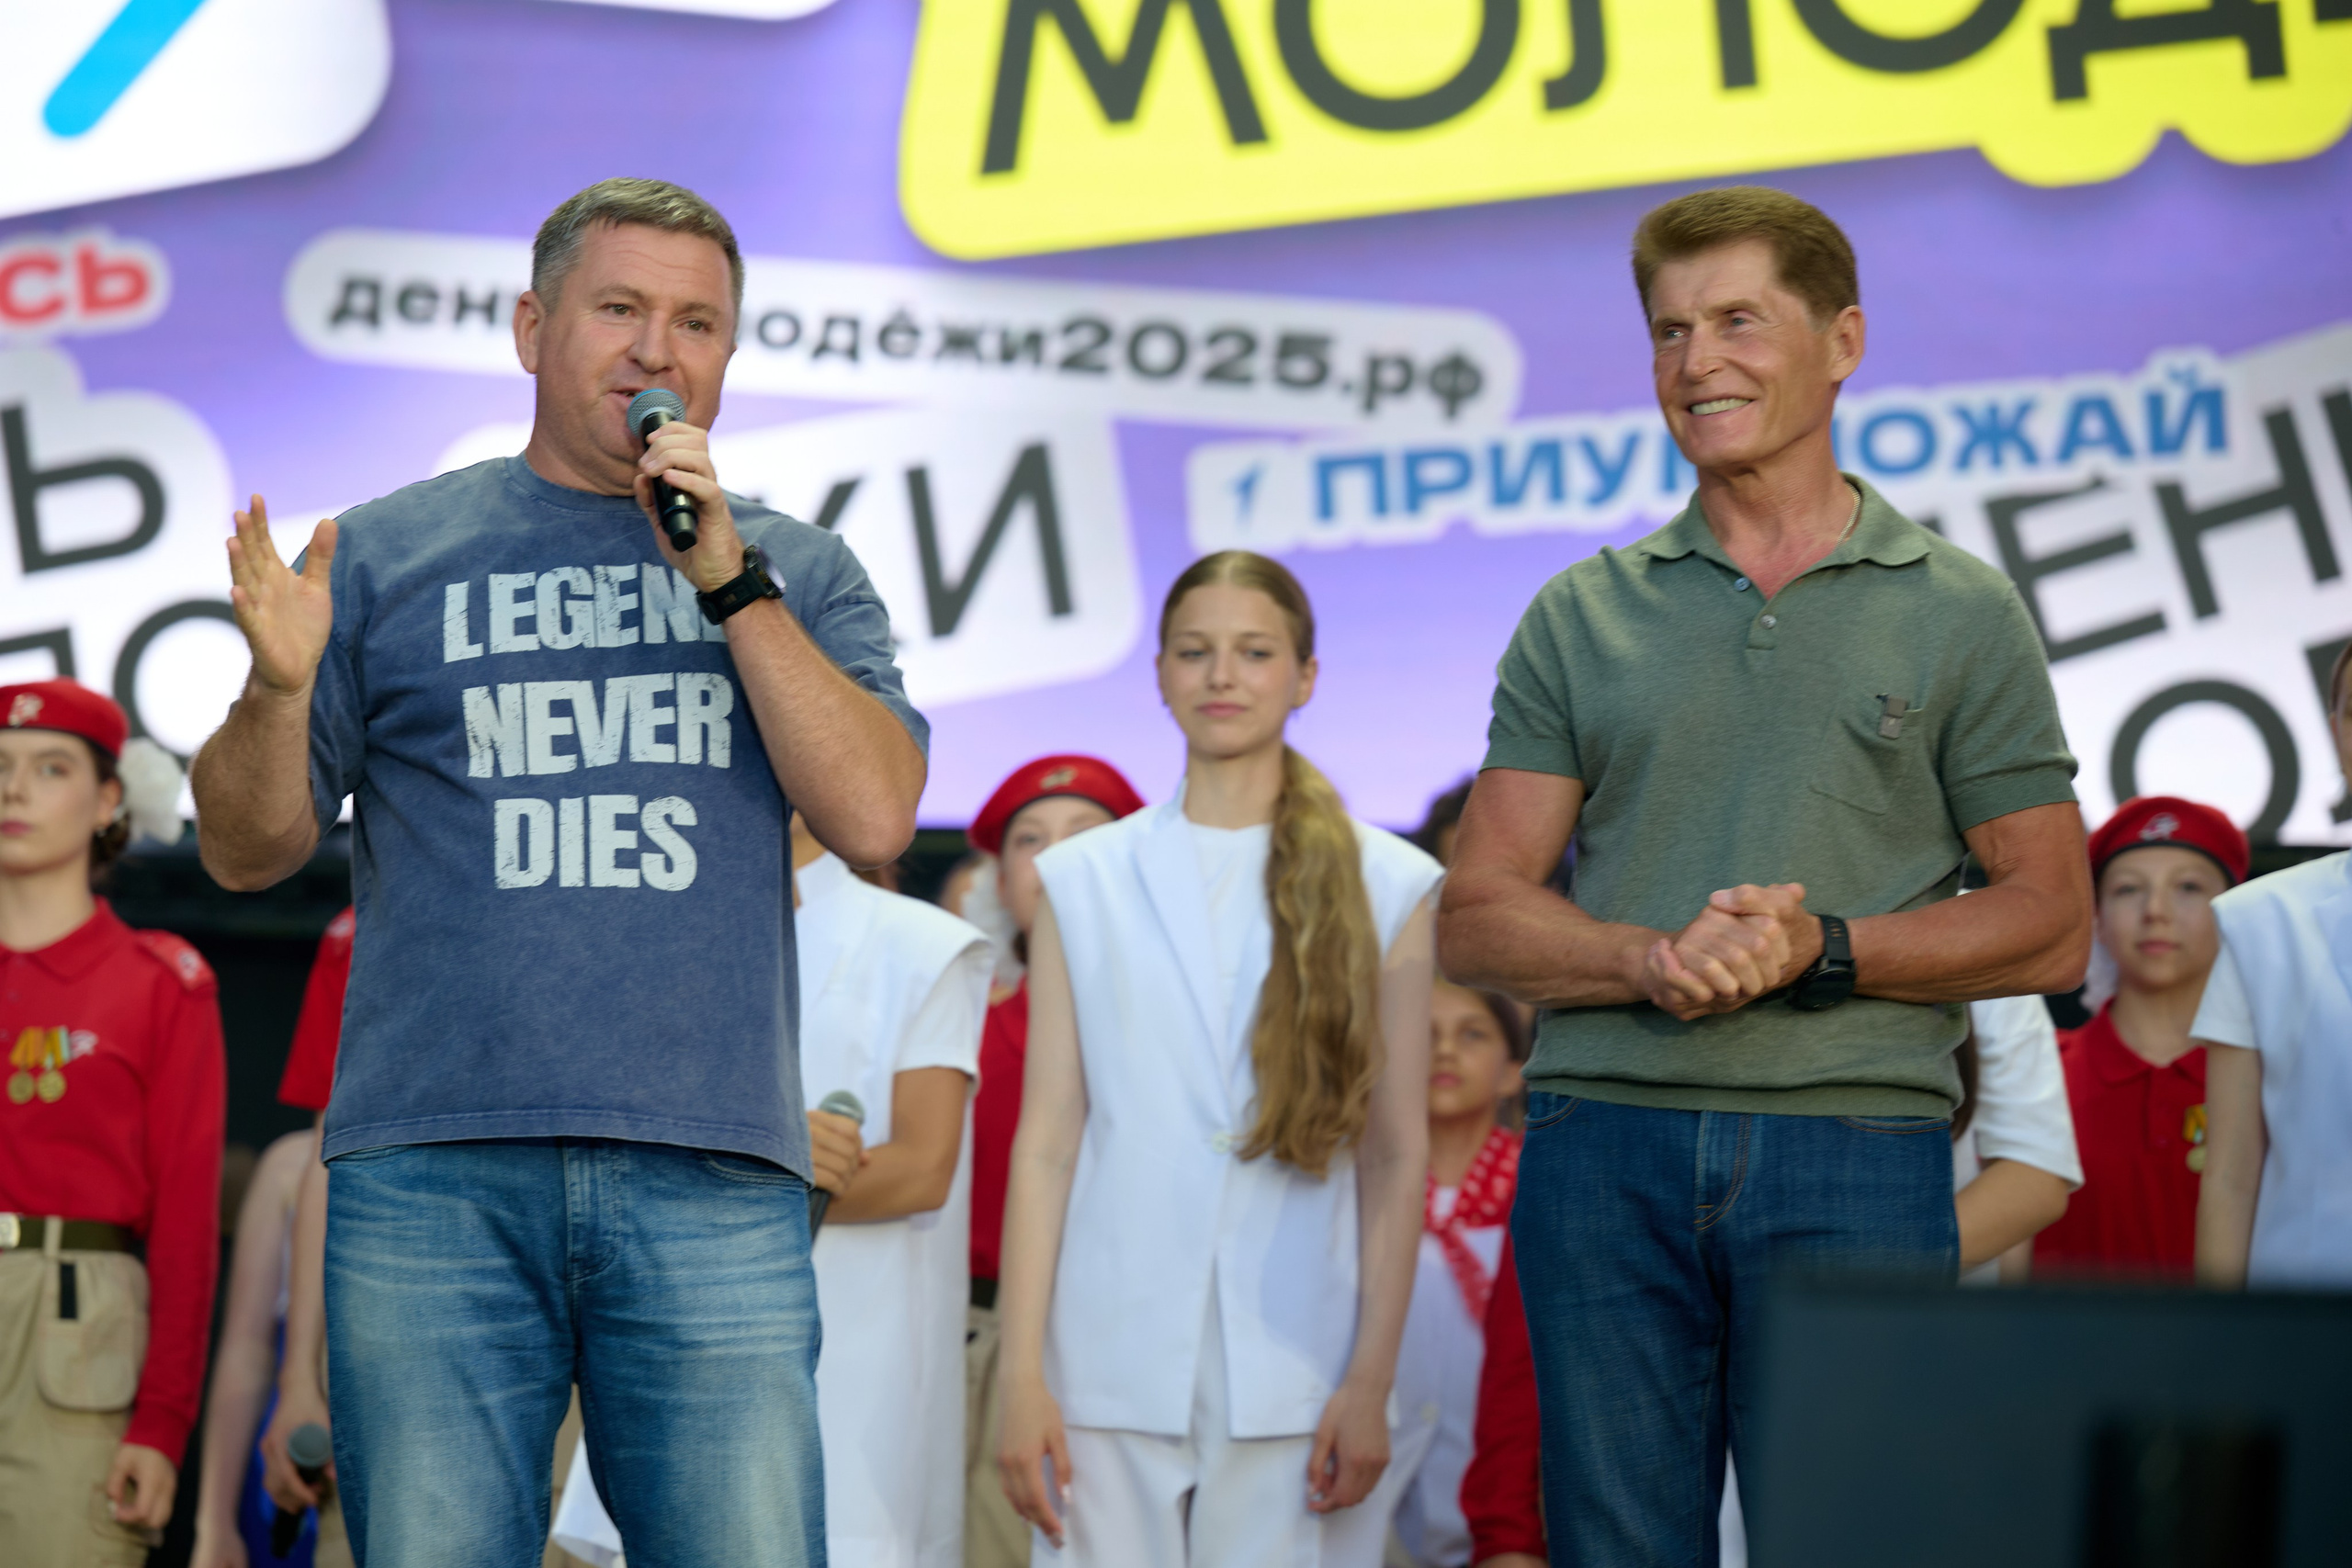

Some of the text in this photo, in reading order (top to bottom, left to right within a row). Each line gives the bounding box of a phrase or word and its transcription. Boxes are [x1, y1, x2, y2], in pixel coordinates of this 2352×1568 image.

[327, 274, 1485, 420] денодёжи2025.рф
[1315, 367, 2227, 522] ПРИУОЖАЙ
[443, 562, 728, 663] LEGEN
[462, 671, 734, 779] NEVER
[494, 794, 698, 892] DIES
